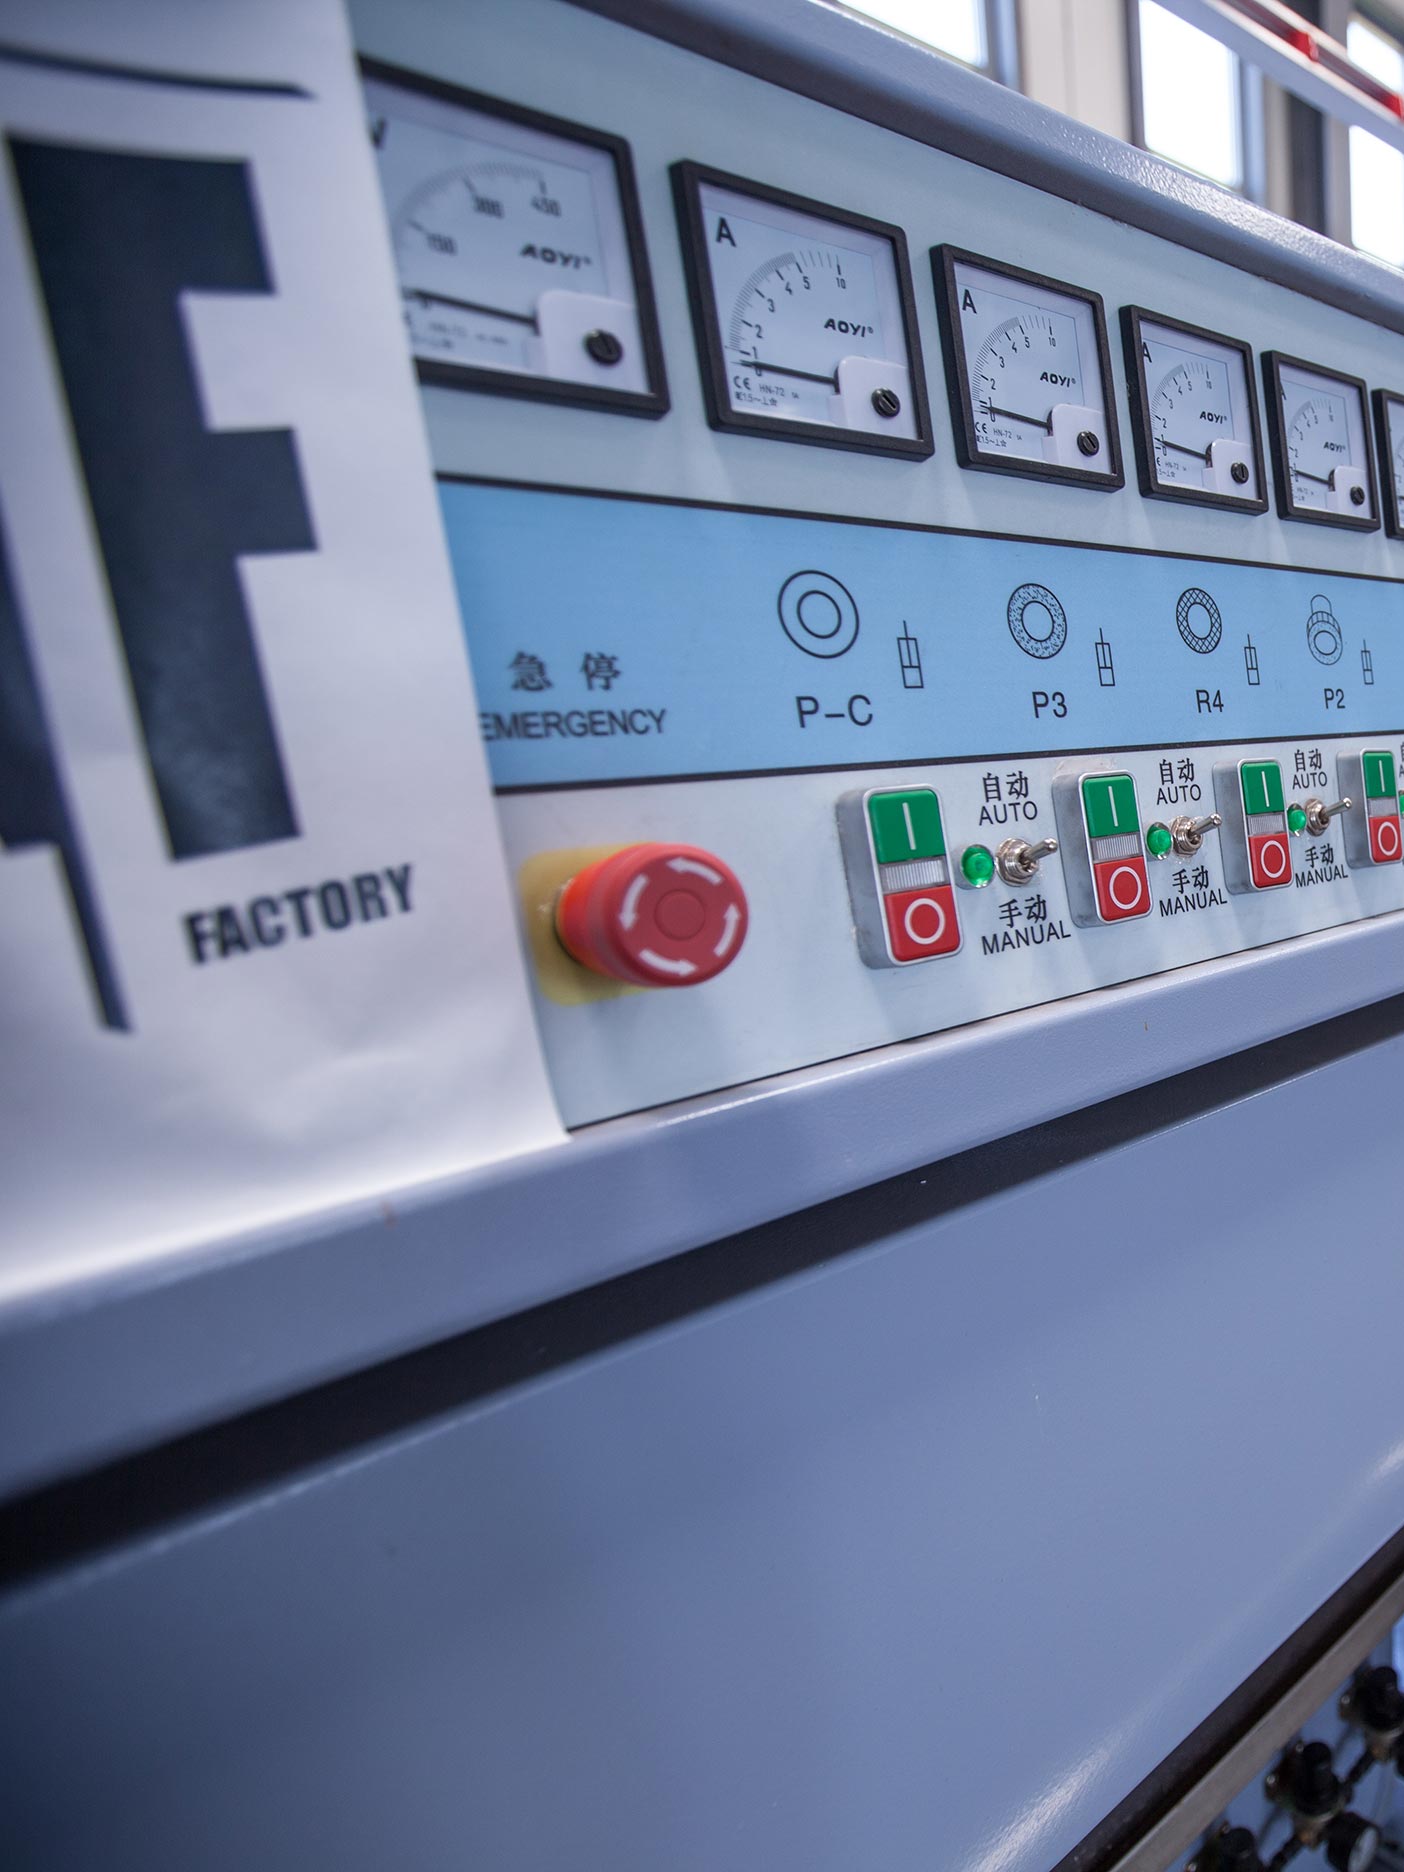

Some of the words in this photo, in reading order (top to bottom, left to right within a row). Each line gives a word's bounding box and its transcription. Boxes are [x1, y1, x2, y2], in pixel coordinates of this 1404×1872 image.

[715, 217, 736, 247] A
[803, 275, 810, 290] 5
[836, 277, 846, 289] 10
[767, 299, 775, 313] 3
[962, 289, 977, 314] A
[755, 324, 763, 339] 2
[1024, 336, 1030, 349] 5
[999, 356, 1005, 368] 3
[1142, 341, 1152, 363] A
[990, 378, 996, 390] 2
[0, 130, 319, 863] F
[796, 694, 874, 728] P-C
[1032, 691, 1068, 718] P3
[1195, 689, 1224, 713] R4
[1324, 688, 1346, 709] P2
[480, 708, 667, 742] EMERGENCY
[1159, 757, 1194, 785] 自动
[1294, 748, 1322, 772] 自动
[983, 771, 1029, 802] 自动
[1292, 772, 1327, 790] AUTO
[1156, 784, 1202, 805] AUTO
[979, 801, 1038, 826] AUTO
[1305, 843, 1334, 868] 手动
[1172, 865, 1209, 894] 手动
[1295, 864, 1348, 888] MANUAL
[998, 894, 1047, 928] 手动
[1159, 888, 1228, 917] MANUAL
[184, 864, 416, 967] FACTORY
[981, 920, 1071, 955] MANUAL
